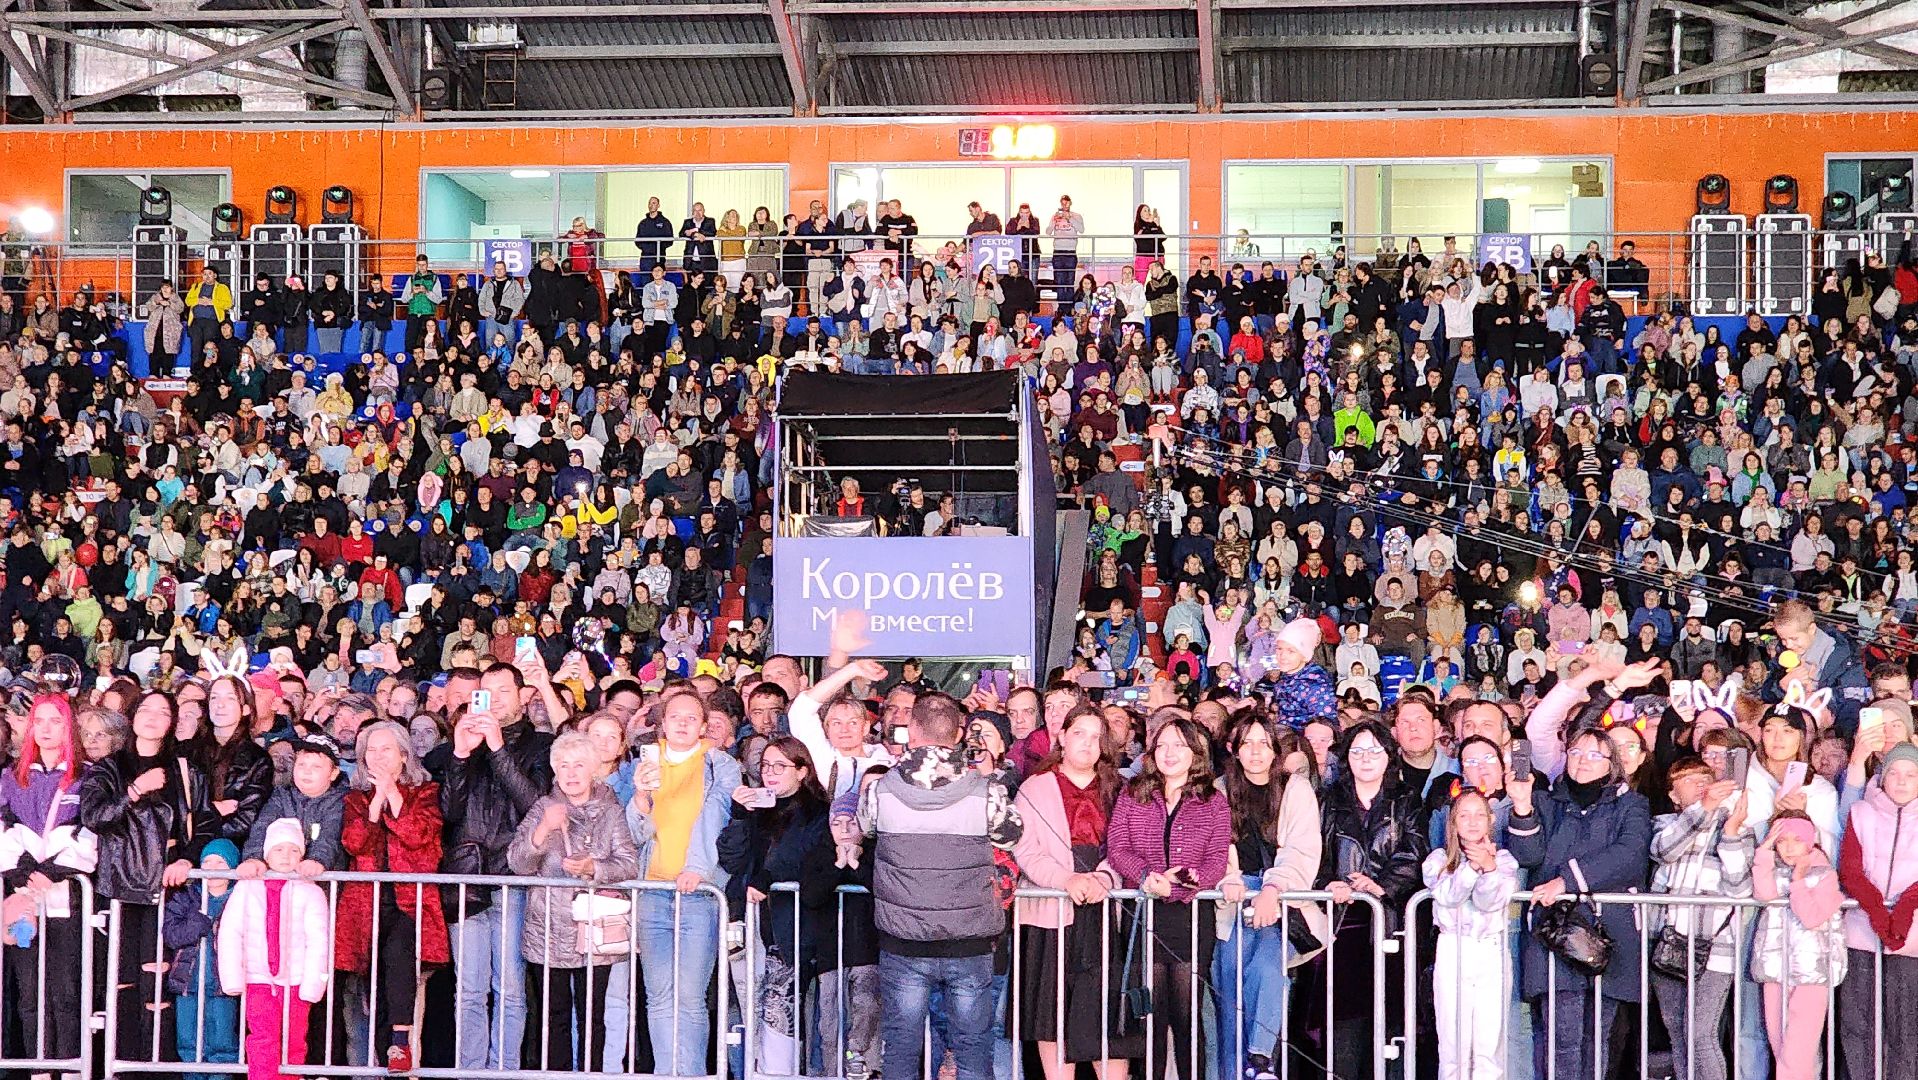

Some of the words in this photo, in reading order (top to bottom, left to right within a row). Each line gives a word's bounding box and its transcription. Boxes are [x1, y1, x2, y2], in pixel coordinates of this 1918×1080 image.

[491, 241, 524, 249] СЕКТОР
[981, 238, 1014, 246] СЕКТОР
[978, 246, 1015, 271] 2В
[1486, 245, 1525, 270] 3В
[801, 557, 1005, 610] Королёв
[870, 608, 974, 632] вместе!
